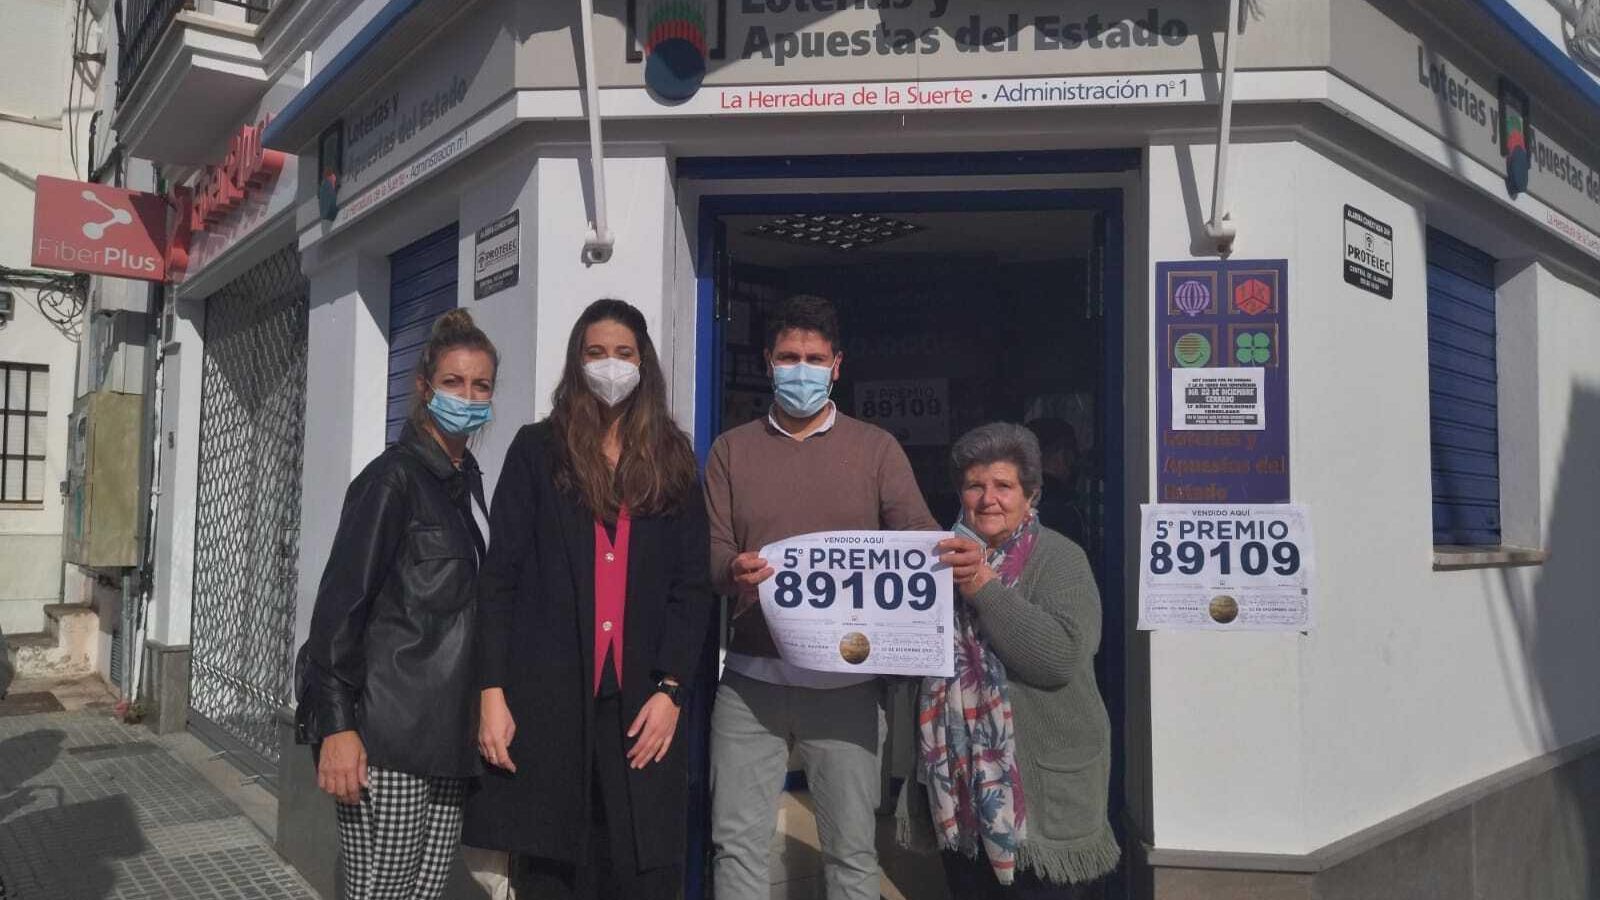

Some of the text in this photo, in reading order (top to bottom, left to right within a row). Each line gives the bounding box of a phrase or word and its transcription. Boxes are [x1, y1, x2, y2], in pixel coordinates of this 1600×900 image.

[741, 8, 1189, 67] Apuestas del Estado
[419, 74, 467, 131] Estado
[721, 92, 743, 109] La
[749, 87, 846, 109] Herradura
[851, 86, 878, 105] de
[884, 86, 901, 104] la
[907, 84, 973, 104] Suerte
[994, 78, 1149, 102] Administración
[1417, 45, 1487, 127] Loterías
[1529, 127, 1583, 193] Apuestas
[38, 238, 156, 272] FiberPlus
[1347, 243, 1391, 275] PROTELEC
[1179, 520, 1289, 540] PREMIO
[809, 548, 927, 570] PREMIO
[1150, 541, 1301, 576] 89109
[773, 571, 937, 611] 89109
